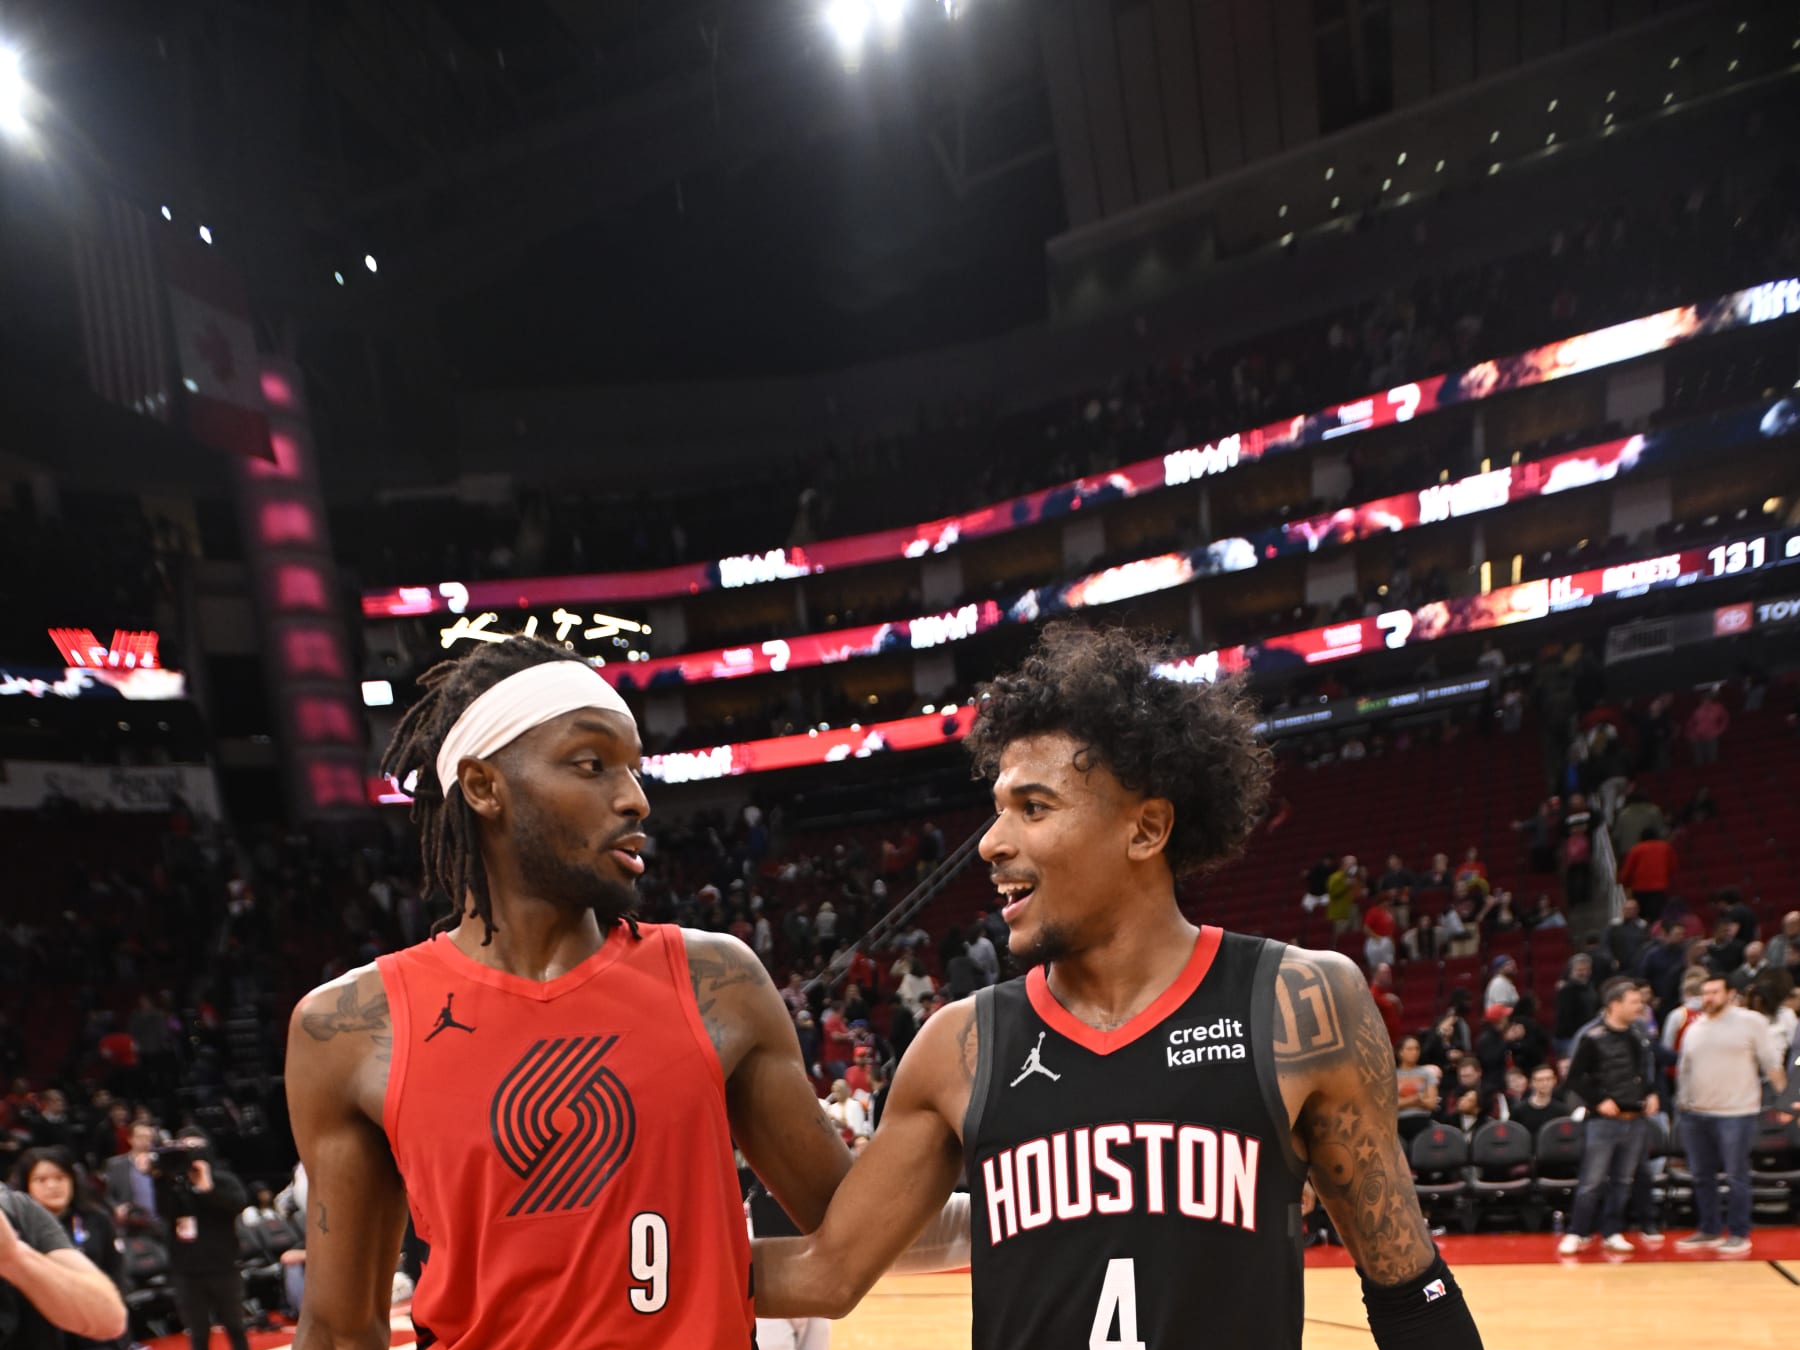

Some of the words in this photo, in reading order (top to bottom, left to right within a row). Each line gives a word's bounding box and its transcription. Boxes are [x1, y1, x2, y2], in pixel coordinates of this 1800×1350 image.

[1708, 536, 1766, 577] 131
[1169, 1018, 1244, 1045] credit
[1166, 1043, 1246, 1067] karma
[982, 1121, 1261, 1246] HOUSTON
[628, 1211, 670, 1315] 9
